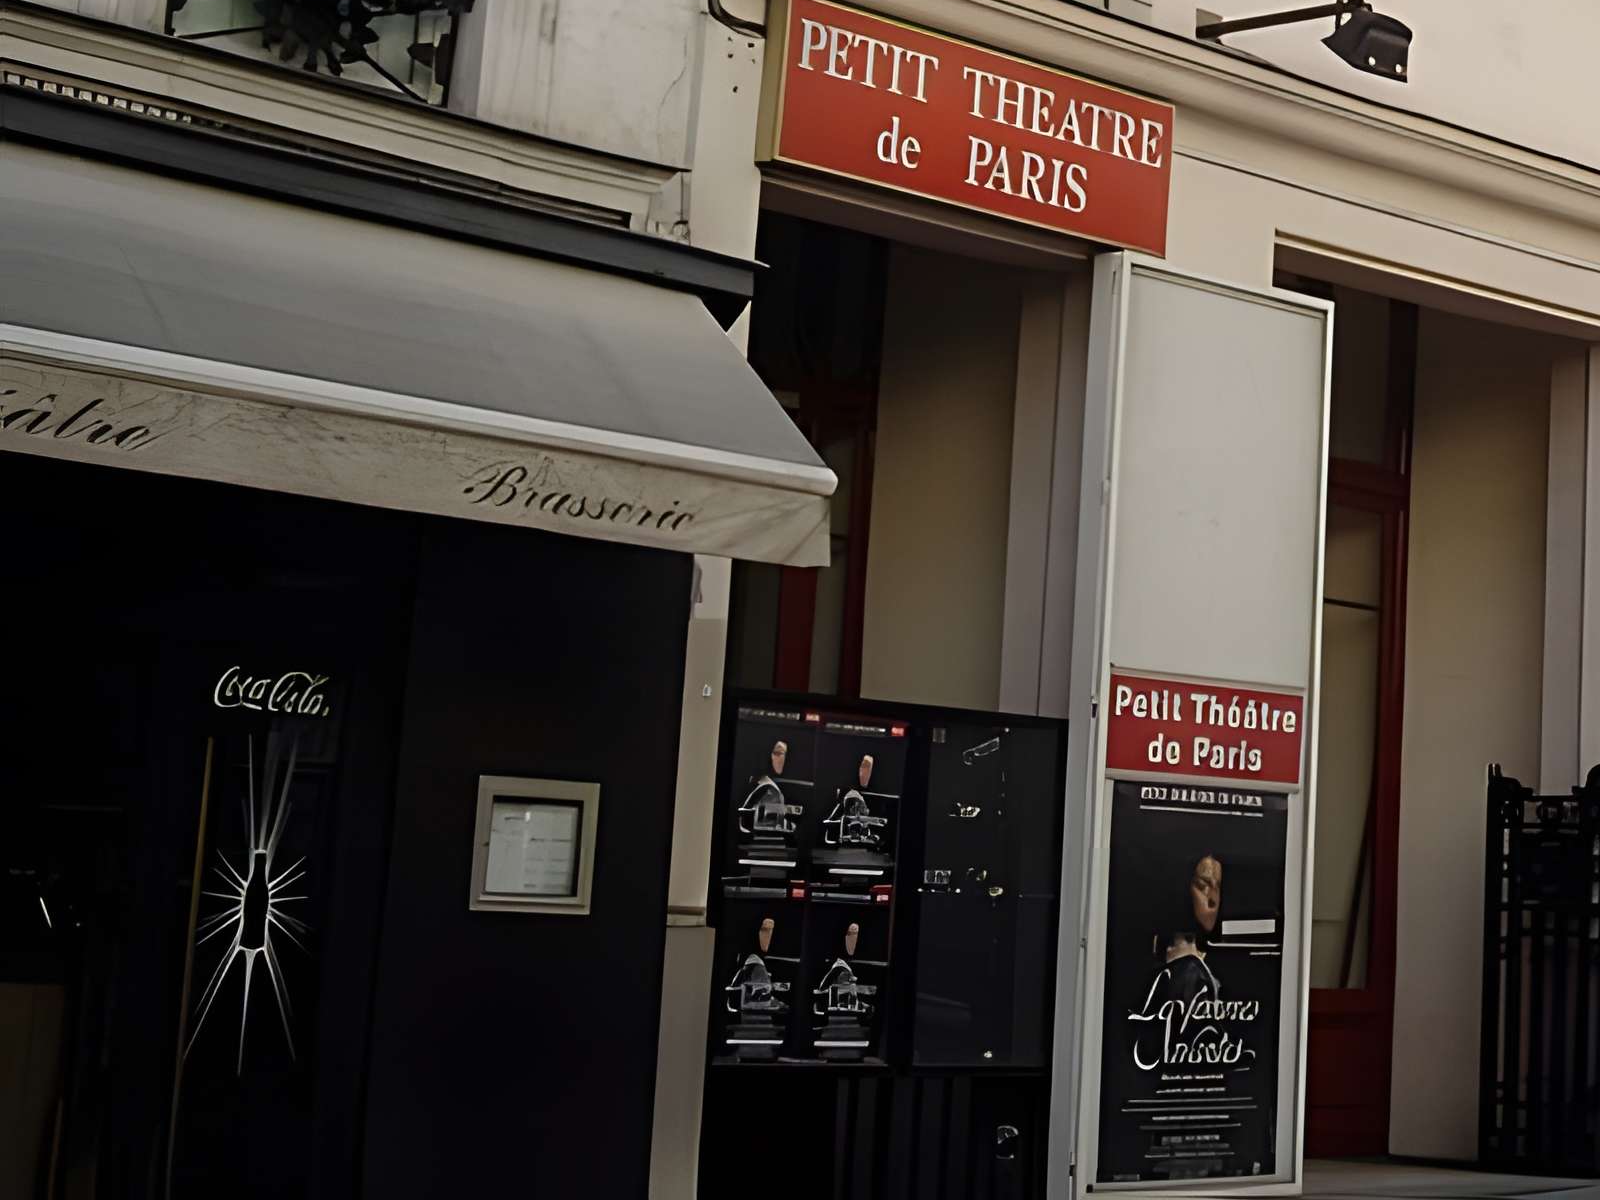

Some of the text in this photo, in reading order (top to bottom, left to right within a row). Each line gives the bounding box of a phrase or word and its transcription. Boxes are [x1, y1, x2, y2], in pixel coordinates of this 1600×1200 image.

[797, 17, 1164, 169] PETIT THEATRE
[876, 116, 1089, 213] de PARIS
[464, 465, 694, 531] Brasserie
[1115, 684, 1182, 722] Petit
[1148, 732, 1263, 772] de Paris
